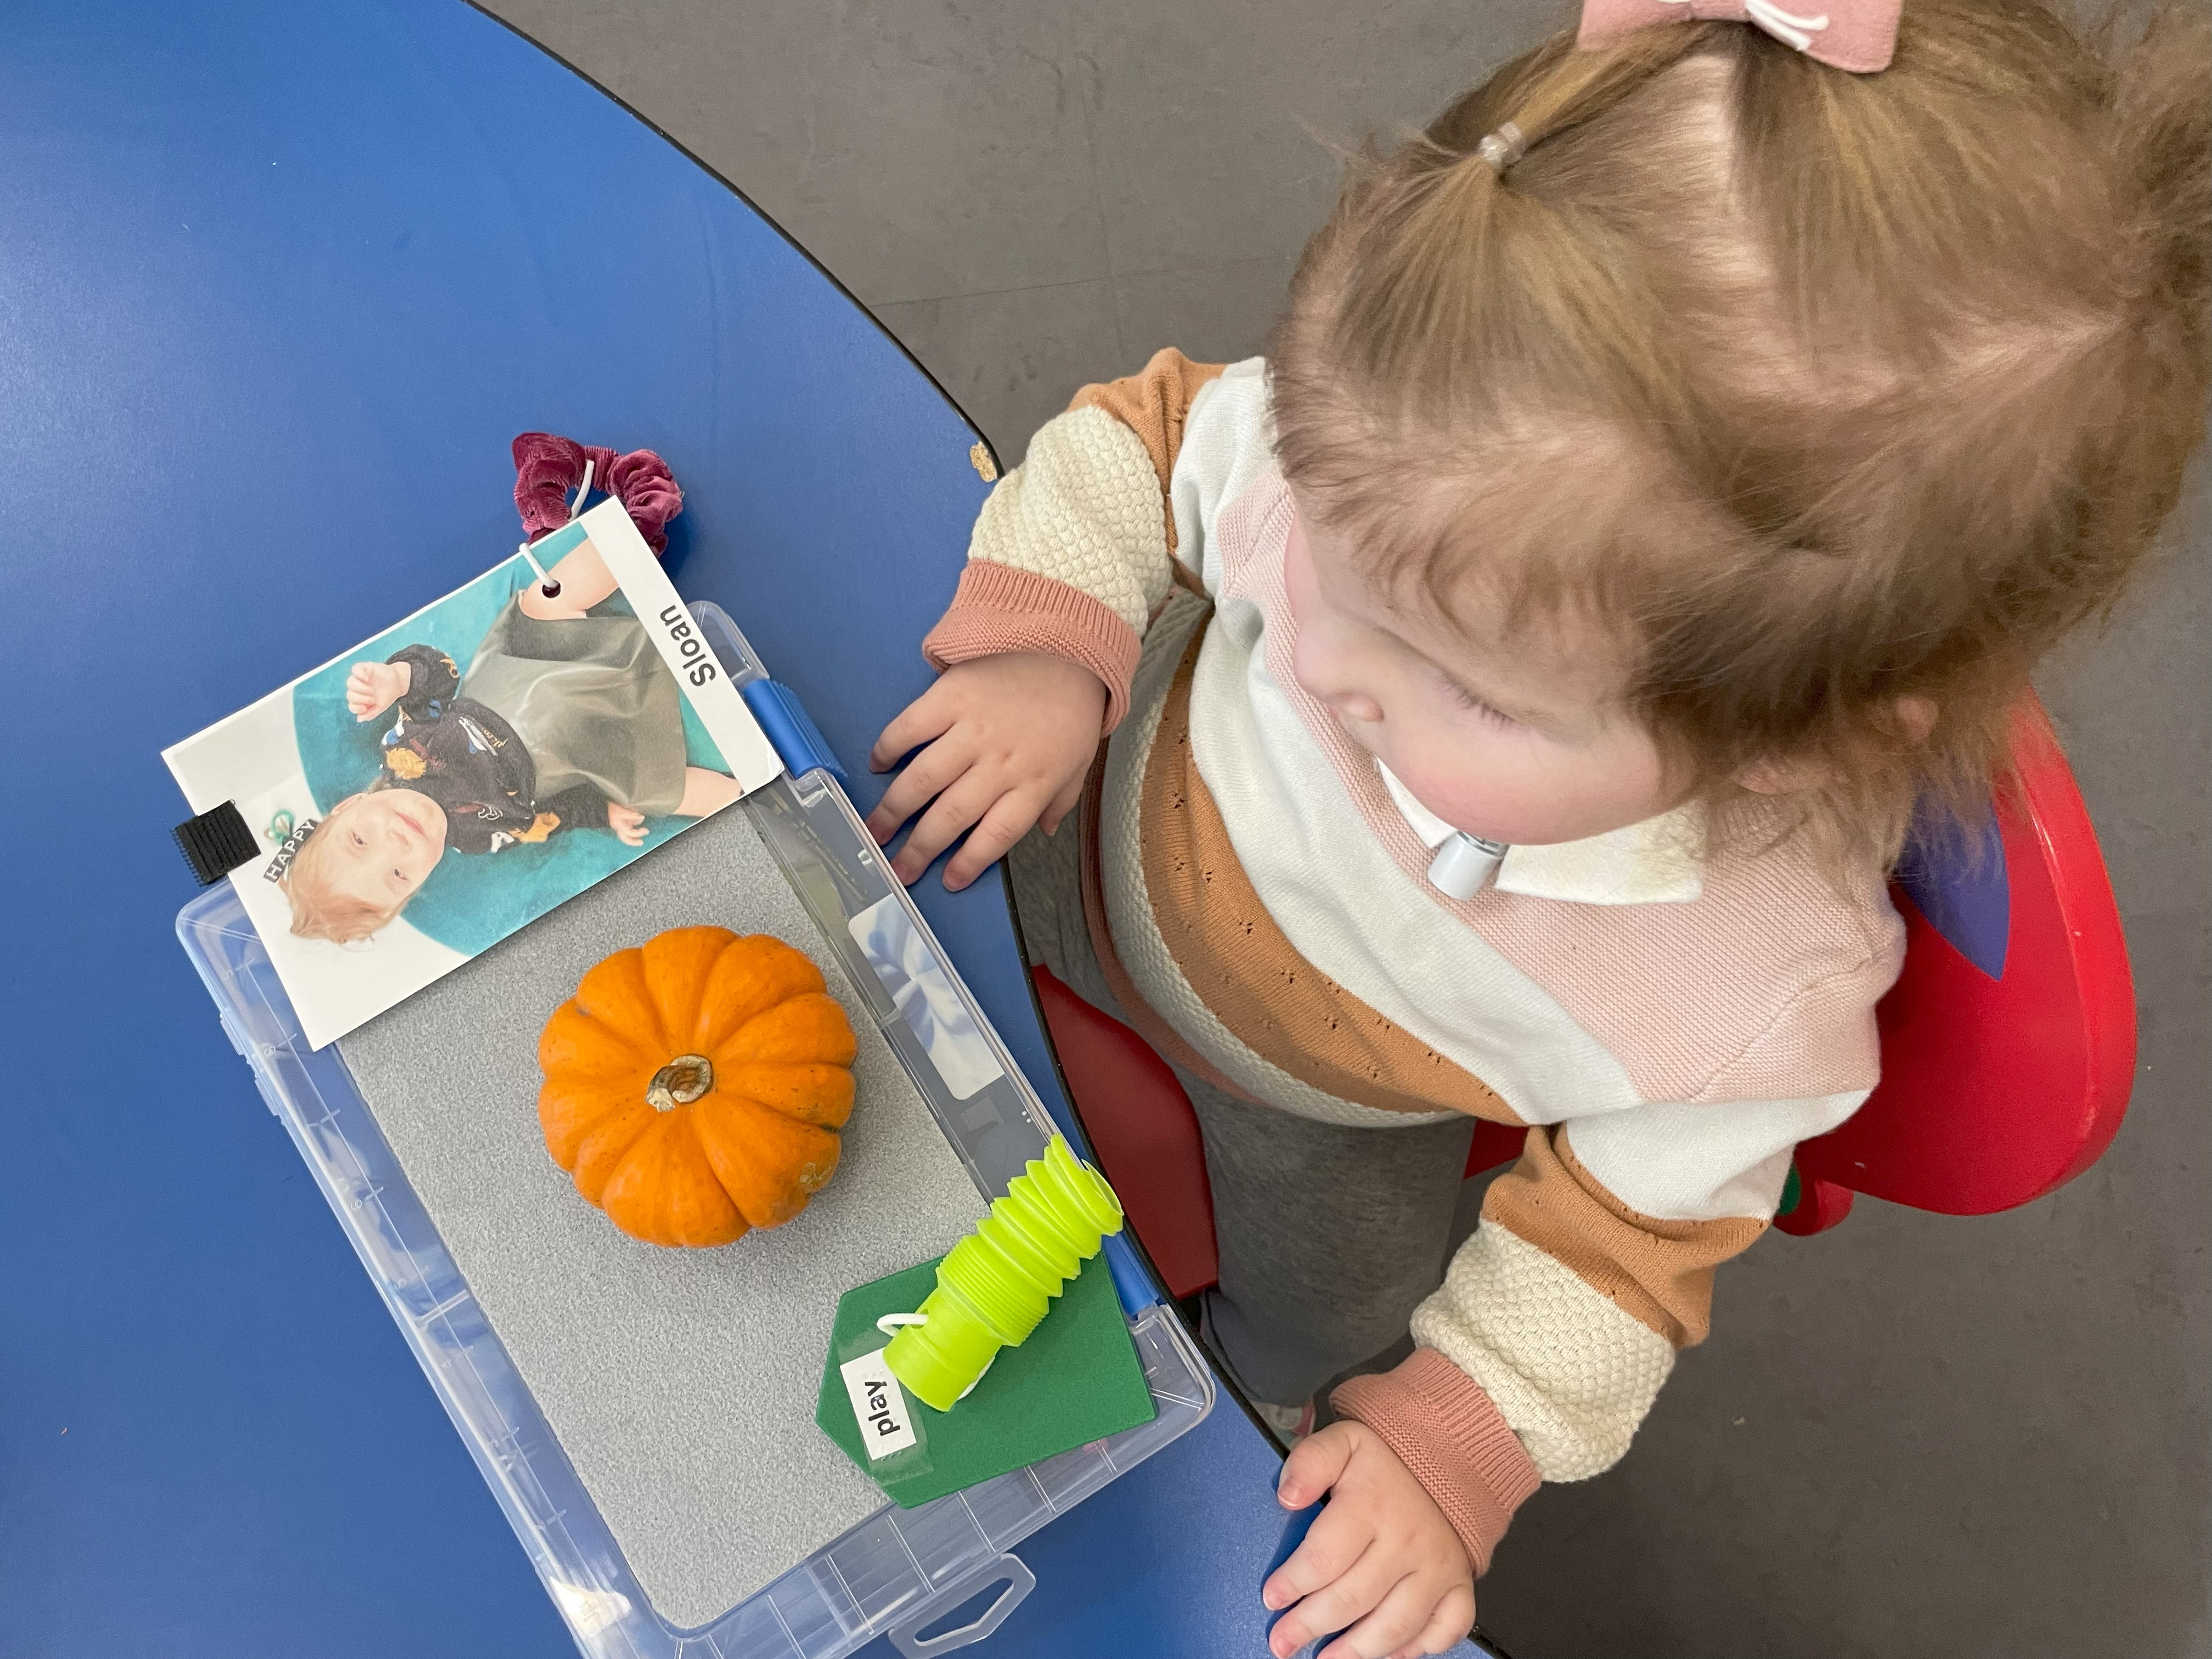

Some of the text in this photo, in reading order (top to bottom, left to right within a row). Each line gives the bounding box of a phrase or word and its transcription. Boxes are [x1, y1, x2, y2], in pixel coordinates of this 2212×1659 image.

[659, 605, 716, 687] Sloan
[266, 820, 315, 880] HAPPY
[263, 1043, 276, 1057] 8
[350, 1199, 363, 1211] 6
[865, 1380, 901, 1436] play
